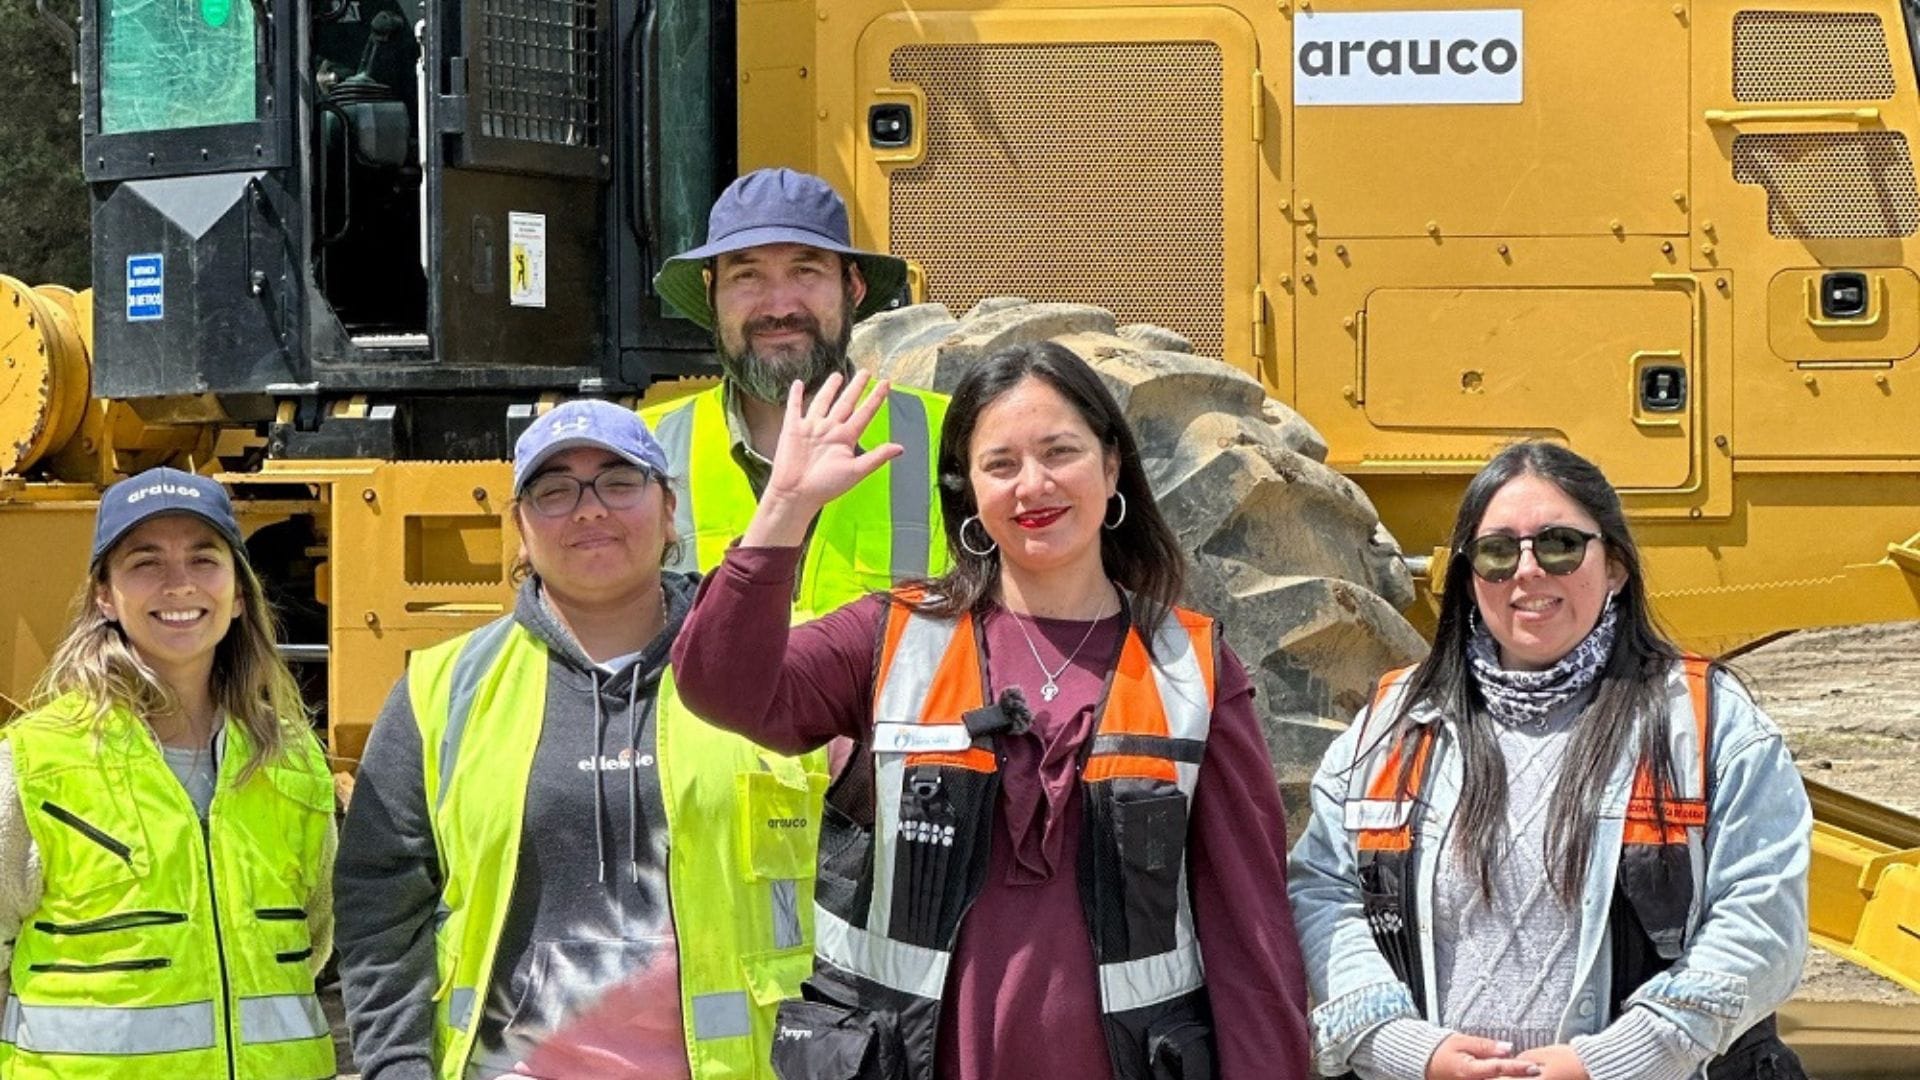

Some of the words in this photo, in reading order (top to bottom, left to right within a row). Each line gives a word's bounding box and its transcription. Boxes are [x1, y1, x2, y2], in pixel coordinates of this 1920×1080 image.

[1298, 38, 1518, 76] arauco
[128, 484, 200, 503] arauco
[768, 818, 808, 829] arauco
